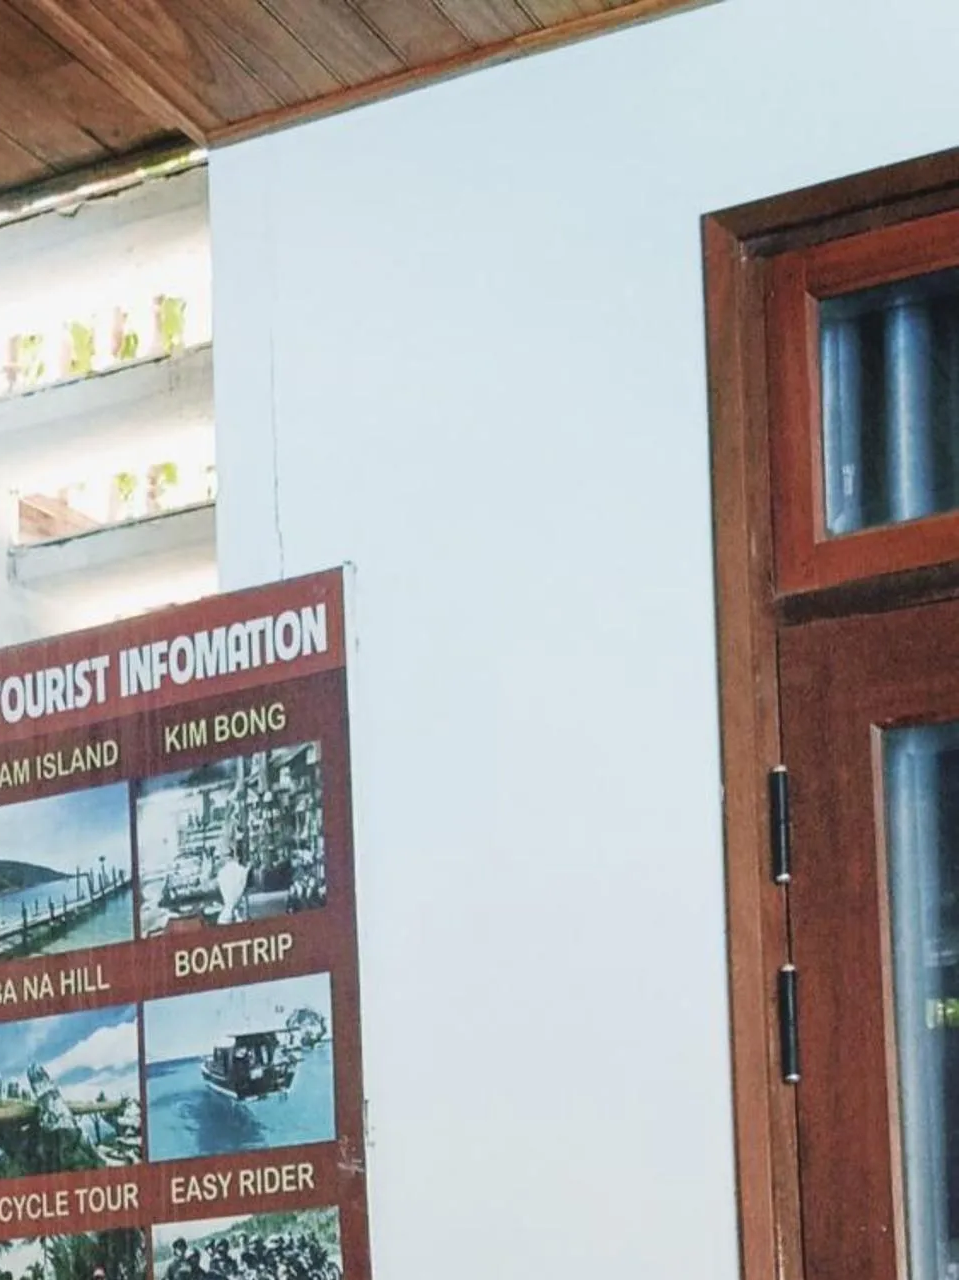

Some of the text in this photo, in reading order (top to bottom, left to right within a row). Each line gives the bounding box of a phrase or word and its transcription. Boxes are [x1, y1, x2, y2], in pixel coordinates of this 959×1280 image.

[119, 603, 328, 697] INFOMATION
[165, 702, 286, 753] KIM BONG
[36, 740, 119, 780] ISLAND
[175, 934, 292, 978] BOATTRIP
[23, 972, 54, 1001] NA
[61, 964, 111, 997] HILL
[74, 1182, 138, 1213] TOUR
[171, 1163, 315, 1205] EASY RIDER
